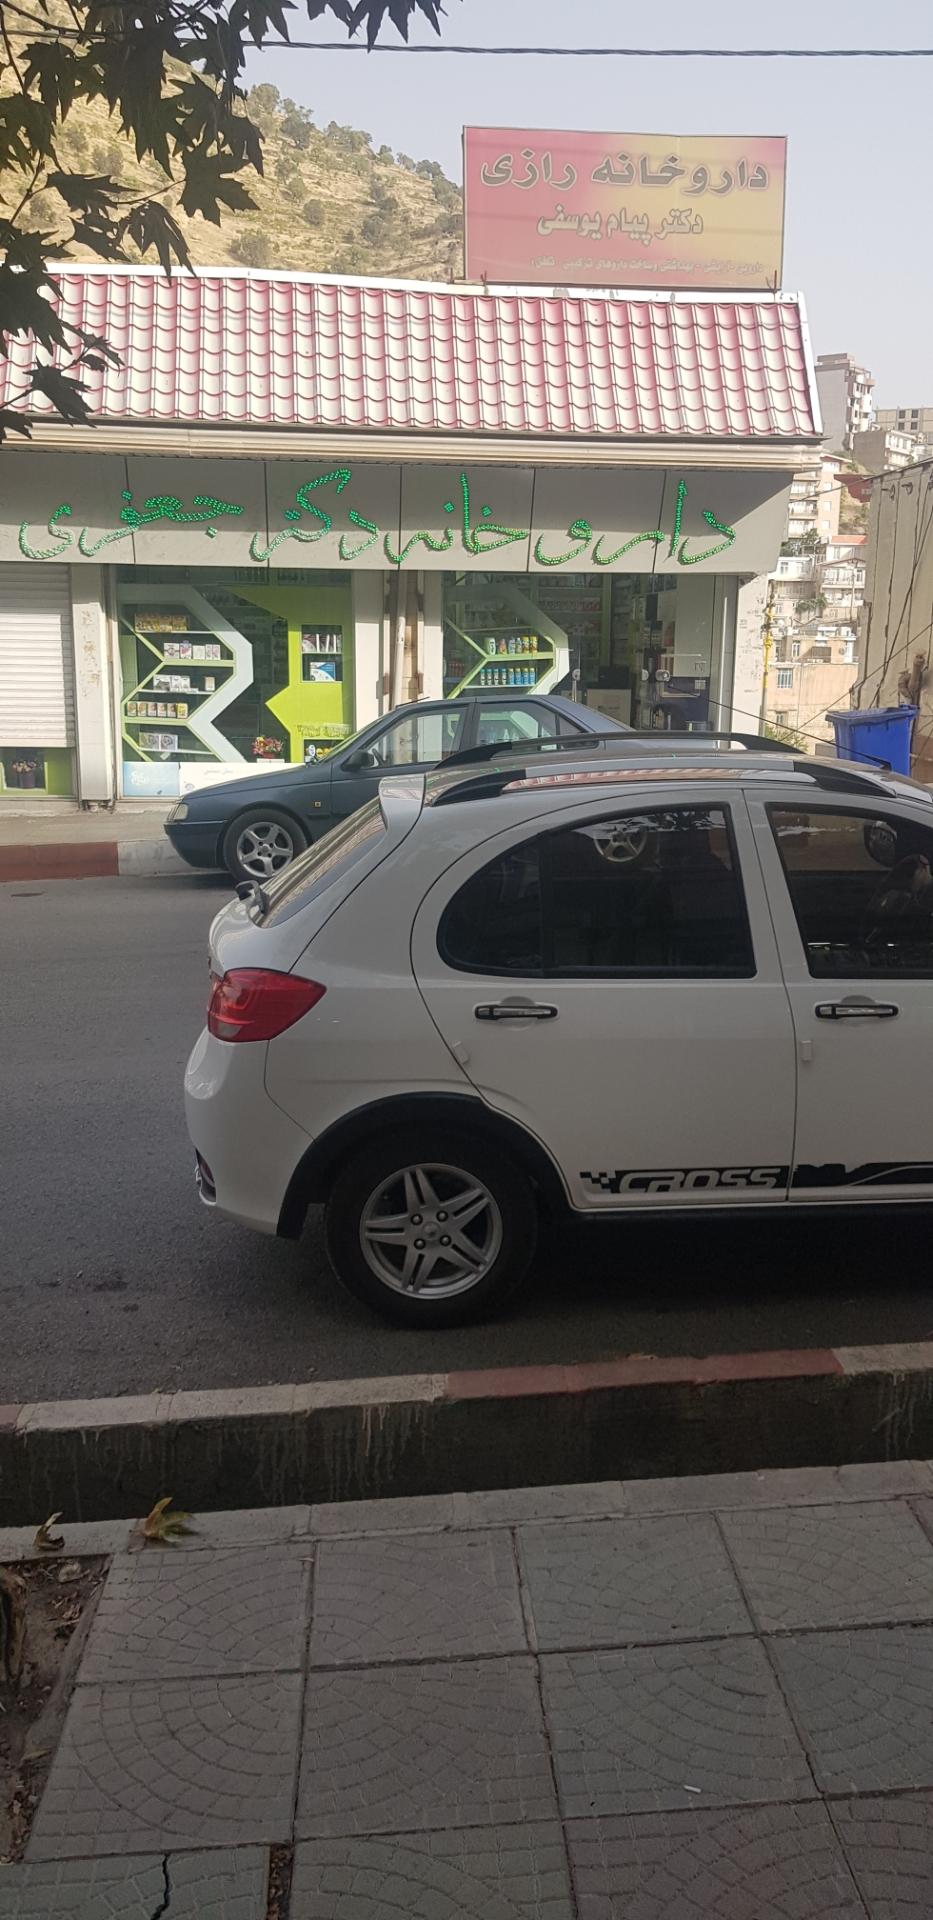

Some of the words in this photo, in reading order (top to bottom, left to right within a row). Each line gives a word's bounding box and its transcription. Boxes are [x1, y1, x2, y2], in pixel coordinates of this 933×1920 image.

[480, 149, 578, 190] رازی
[590, 152, 769, 196] داروخانه
[536, 203, 602, 240] یوسفی
[606, 207, 653, 245] پیام
[655, 207, 704, 239] دکتر
[19, 489, 244, 560] جعفری
[249, 468, 380, 561] دکتر
[384, 472, 737, 565] داروخانه
[618, 1167, 782, 1193] CROSS
